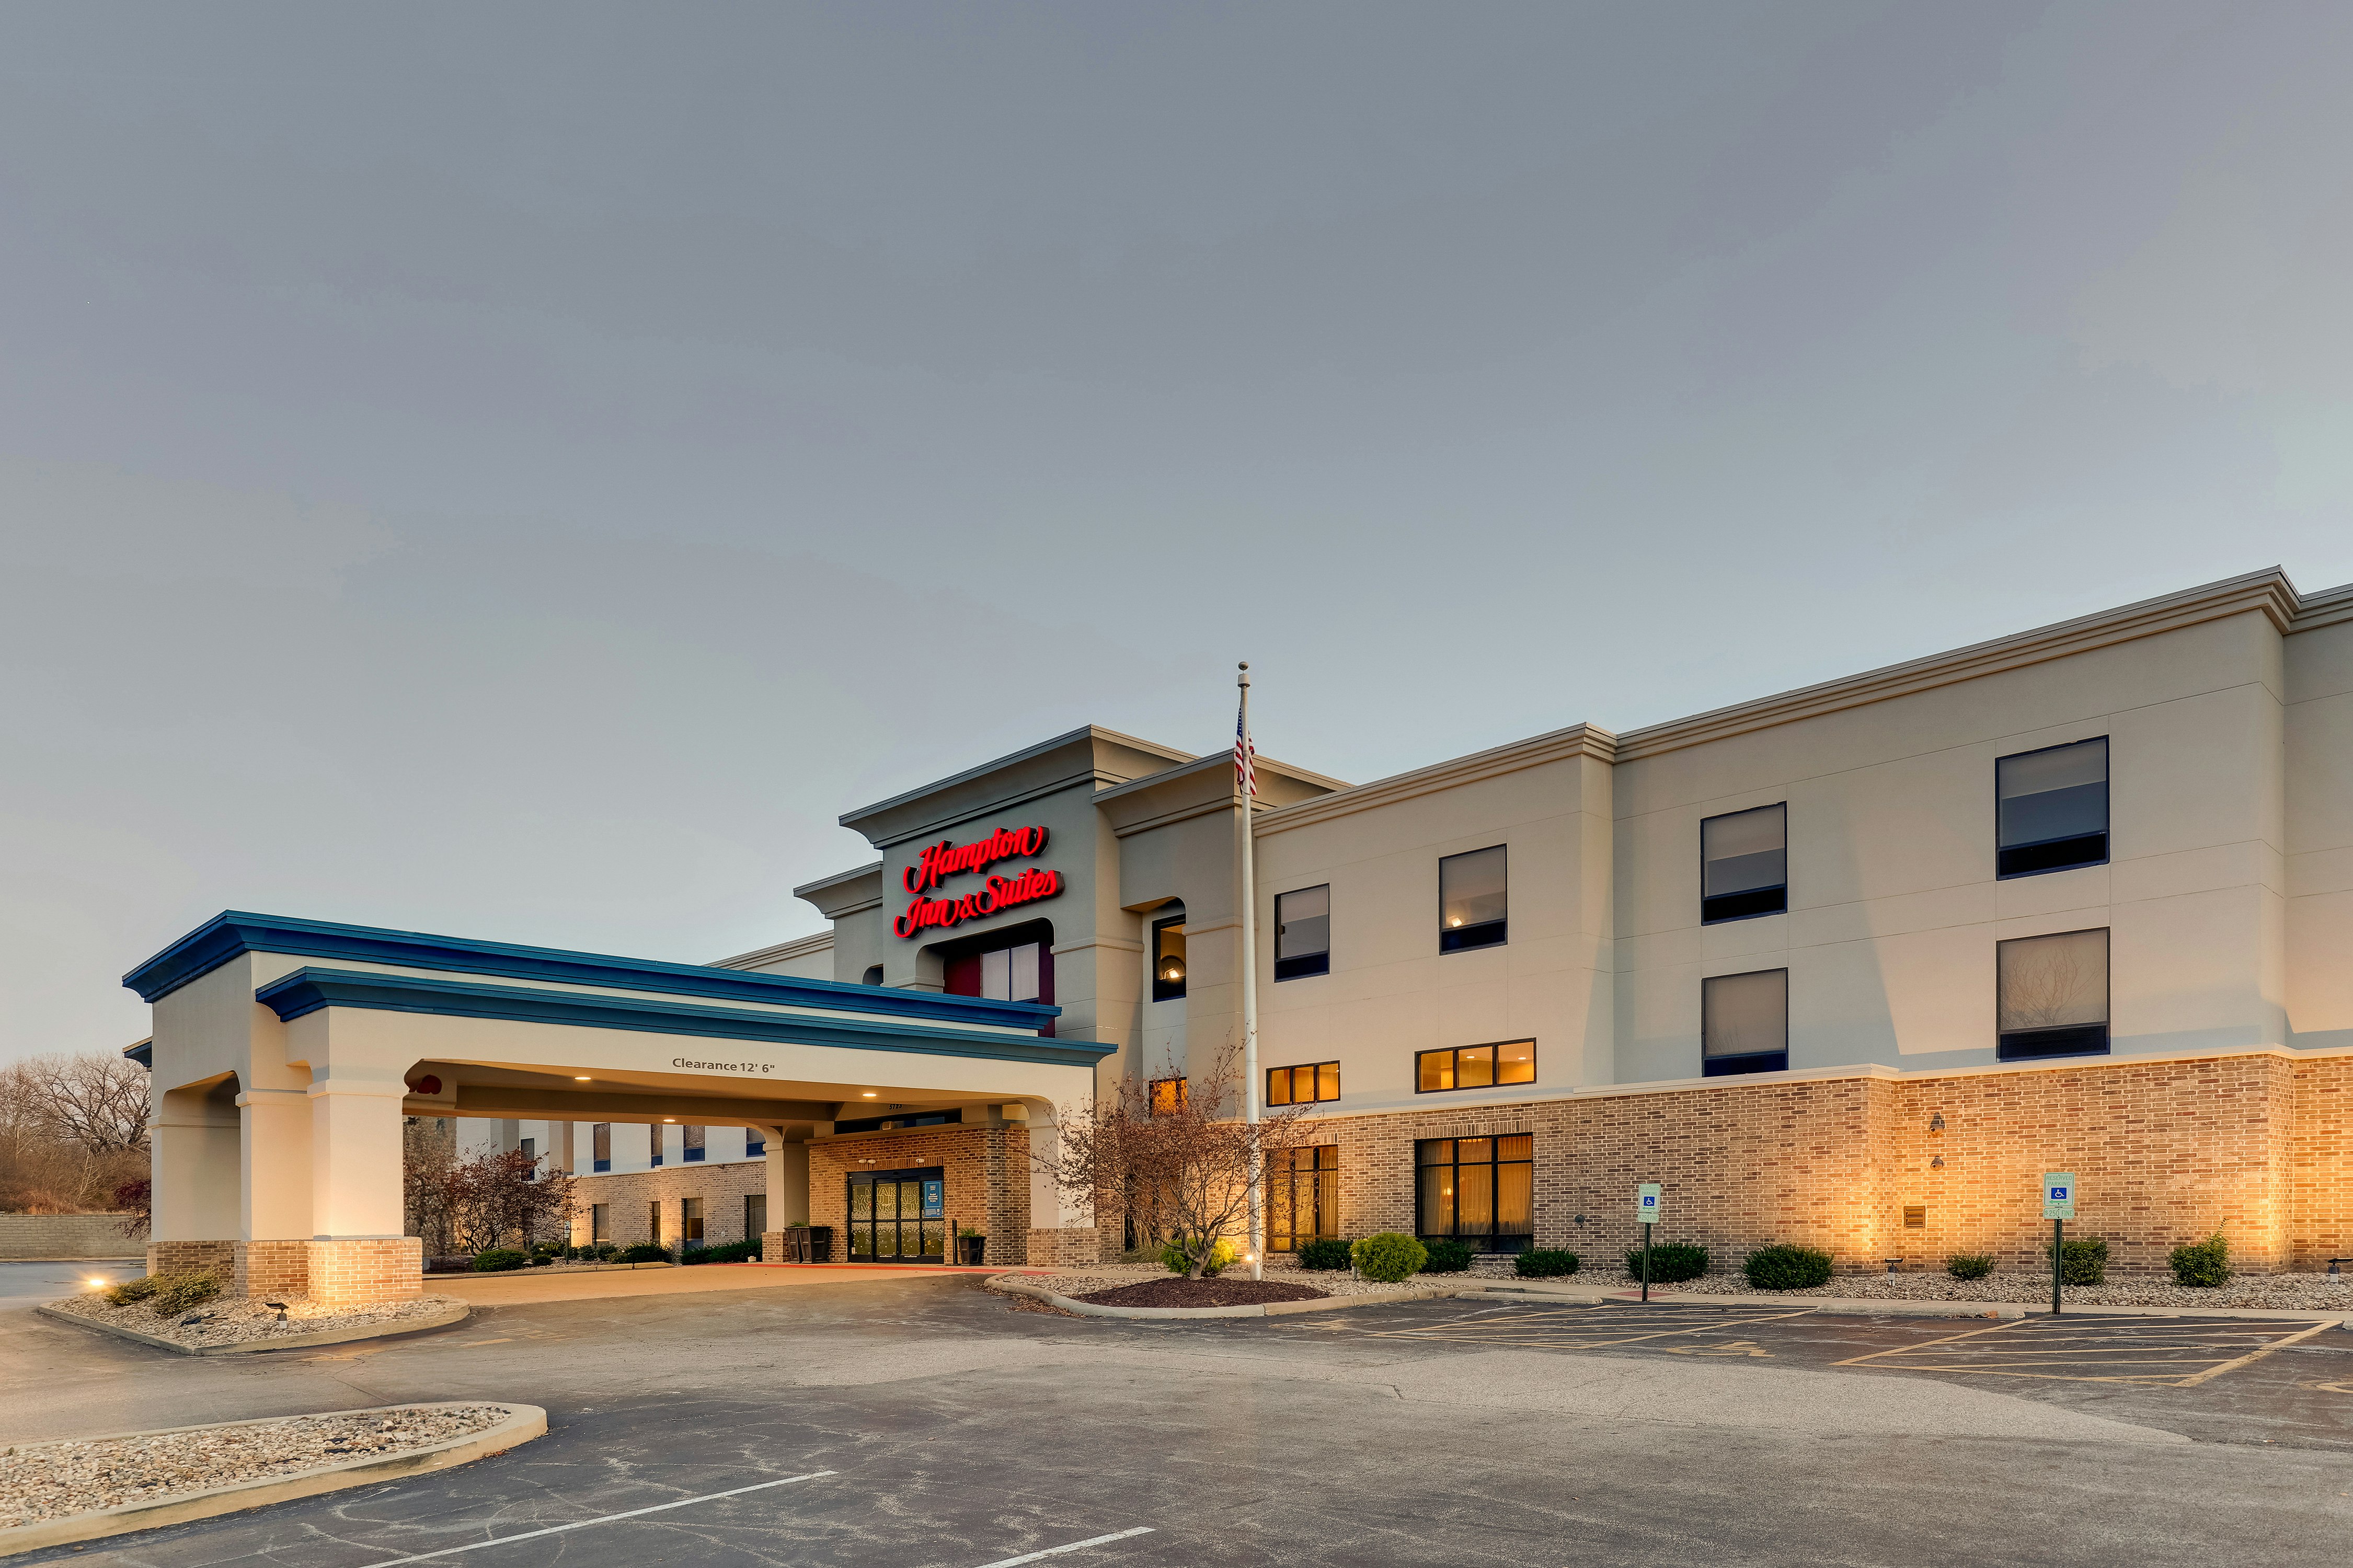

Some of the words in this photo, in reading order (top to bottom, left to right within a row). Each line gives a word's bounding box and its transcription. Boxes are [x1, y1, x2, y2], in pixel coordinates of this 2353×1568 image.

[903, 825, 1049, 895] Hampton
[893, 896, 962, 939] Inn
[959, 893, 980, 920] &
[975, 868, 1063, 914] Suites
[672, 1058, 738, 1071] Clearance
[740, 1063, 758, 1072] 12'
[762, 1064, 775, 1073] 6"
[865, 1186, 920, 1196] MAKNG
